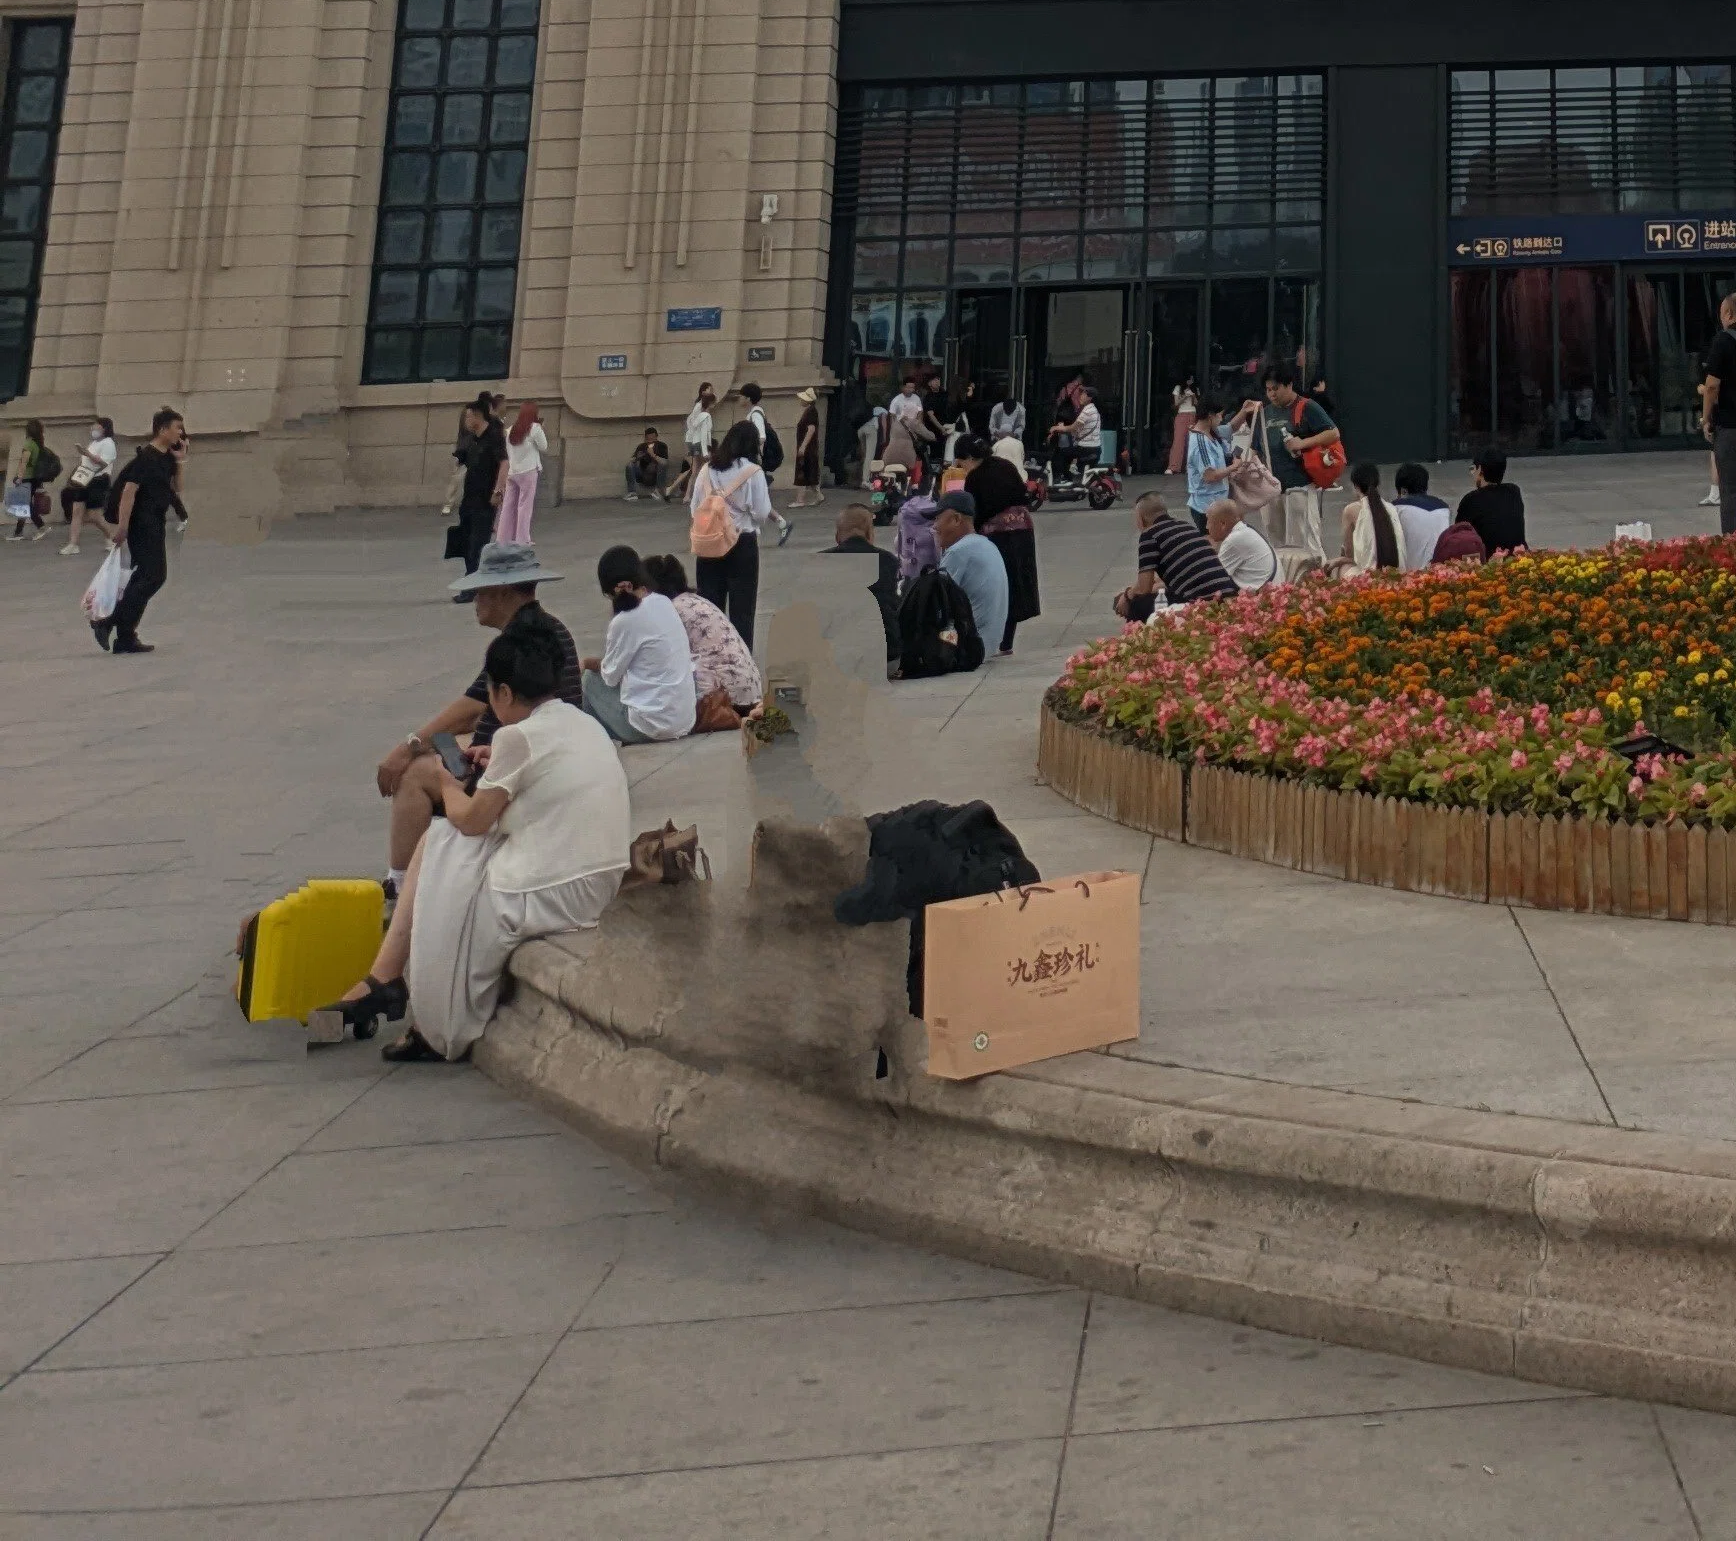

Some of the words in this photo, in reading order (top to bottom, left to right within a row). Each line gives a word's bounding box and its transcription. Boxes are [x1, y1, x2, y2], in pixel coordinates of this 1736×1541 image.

[1512, 236, 1563, 249] 铁路到达口
